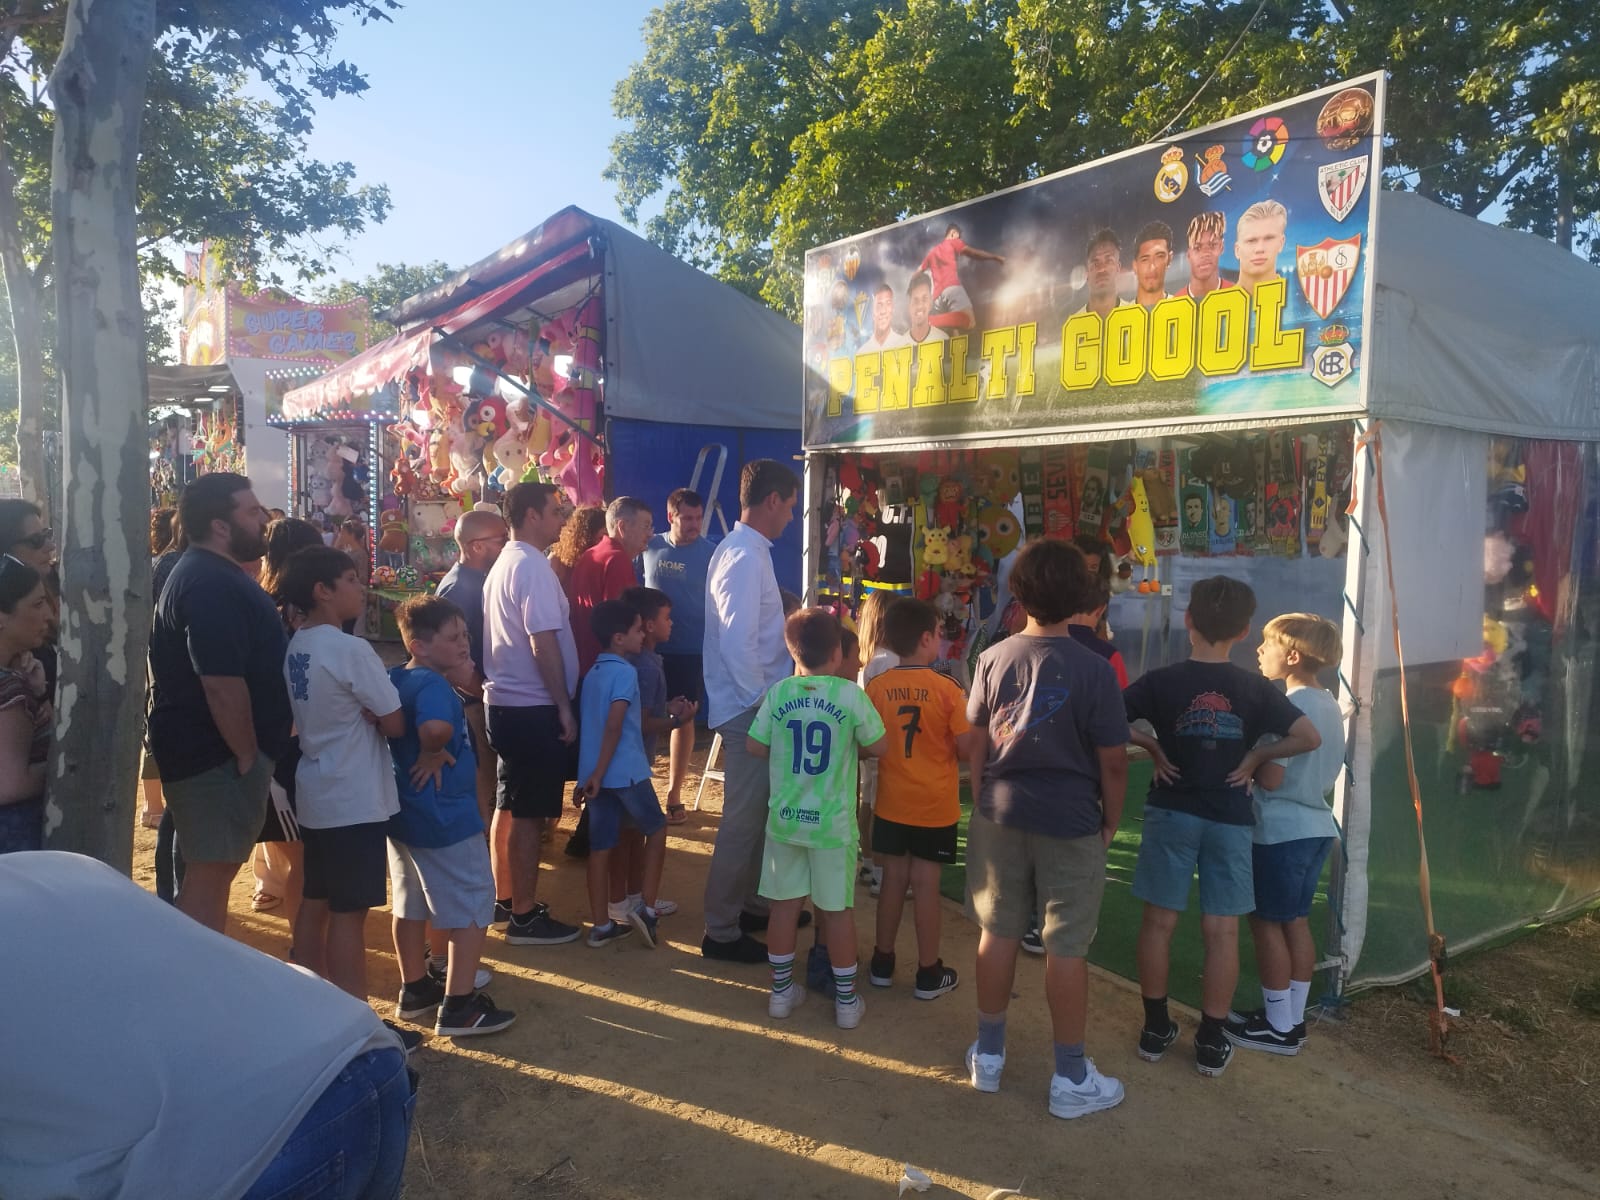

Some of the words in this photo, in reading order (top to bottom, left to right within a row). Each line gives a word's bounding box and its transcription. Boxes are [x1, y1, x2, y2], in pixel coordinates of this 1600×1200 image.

[244, 309, 325, 336] SUPER
[269, 331, 357, 354] GAMES
[827, 322, 1038, 417] PENALTI
[1060, 278, 1305, 391] GOOOL
[886, 687, 911, 702] VINI
[913, 688, 929, 702] JR
[772, 697, 810, 722] LAMINE
[812, 697, 848, 725] YAMAL
[896, 705, 922, 759] 7
[786, 719, 832, 776] 19
